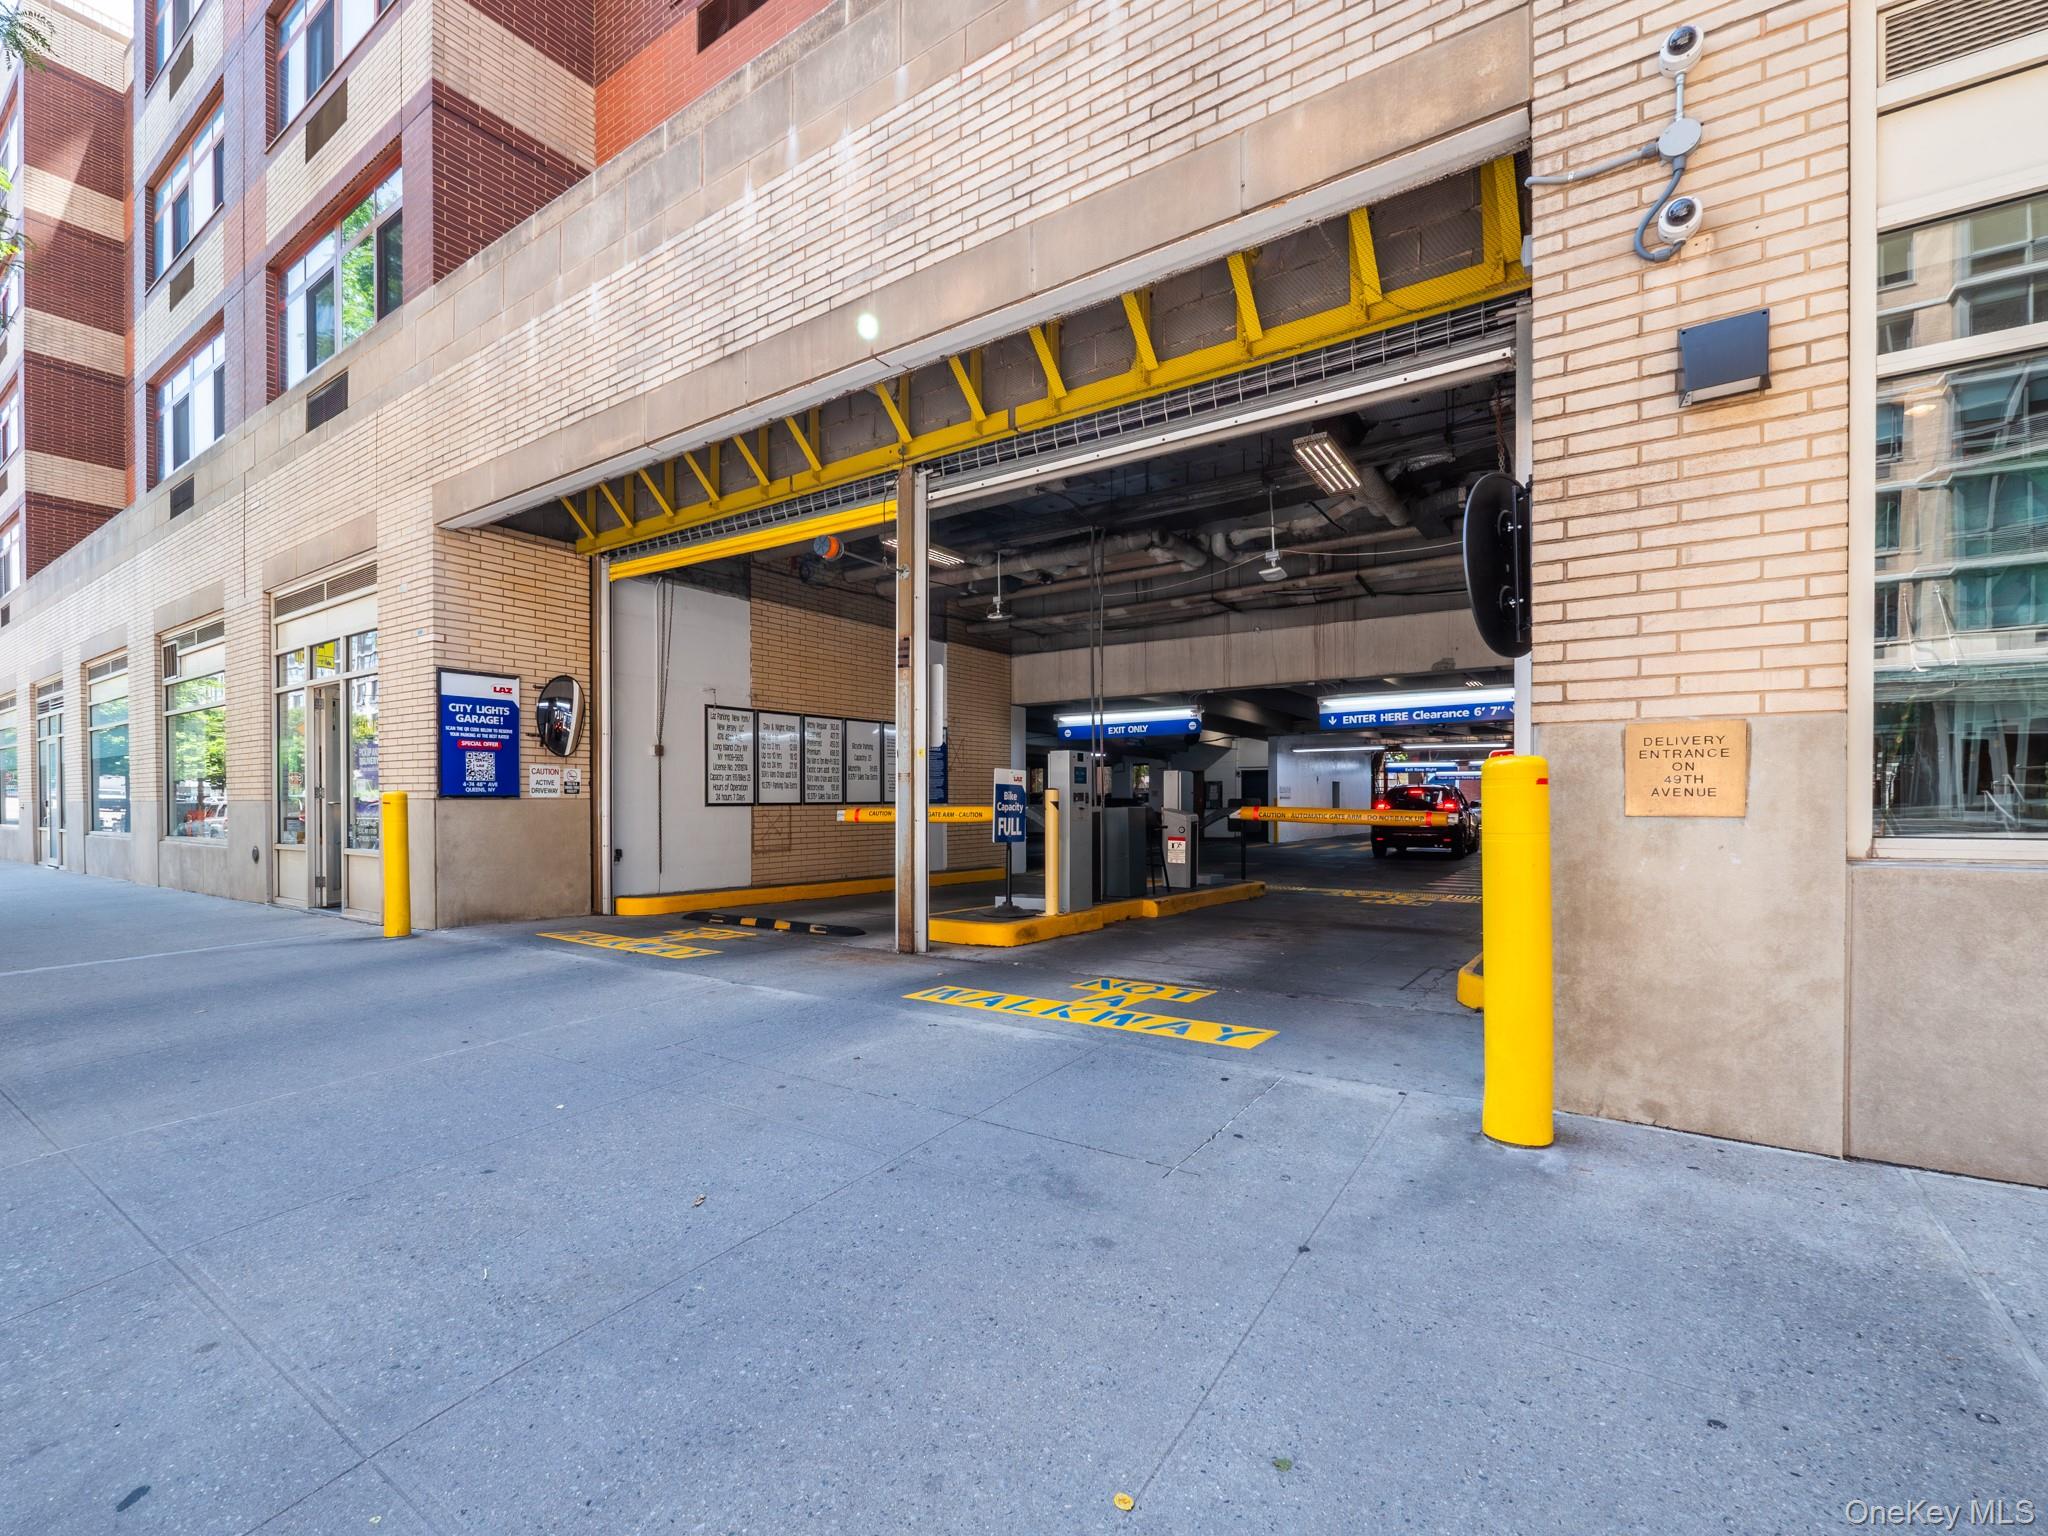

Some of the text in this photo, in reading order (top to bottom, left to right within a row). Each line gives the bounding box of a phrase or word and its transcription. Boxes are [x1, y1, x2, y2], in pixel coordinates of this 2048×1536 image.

[449, 703, 510, 715] CITY LIGHTS
[456, 714, 504, 725] GARAGE!
[1343, 715, 1376, 725] ENTER
[1380, 712, 1408, 722] HERE
[1413, 707, 1470, 720] Clearance
[1108, 725, 1148, 734] EXIT ONLY
[1644, 736, 1726, 746] DELIVERY
[1639, 748, 1730, 759] ENTRANCE
[1672, 762, 1695, 771] ON
[1664, 775, 1704, 784] 49TH
[1004, 791, 1017, 800] Bike
[1651, 787, 1717, 797] AVENUE
[997, 802, 1023, 814] Capacity
[1258, 811, 1286, 819] CAUTION
[998, 817, 1022, 836] FULL
[1079, 978, 1202, 999] NOT
[1076, 995, 1128, 1007] A
[919, 987, 1262, 1042] WALKWAY
